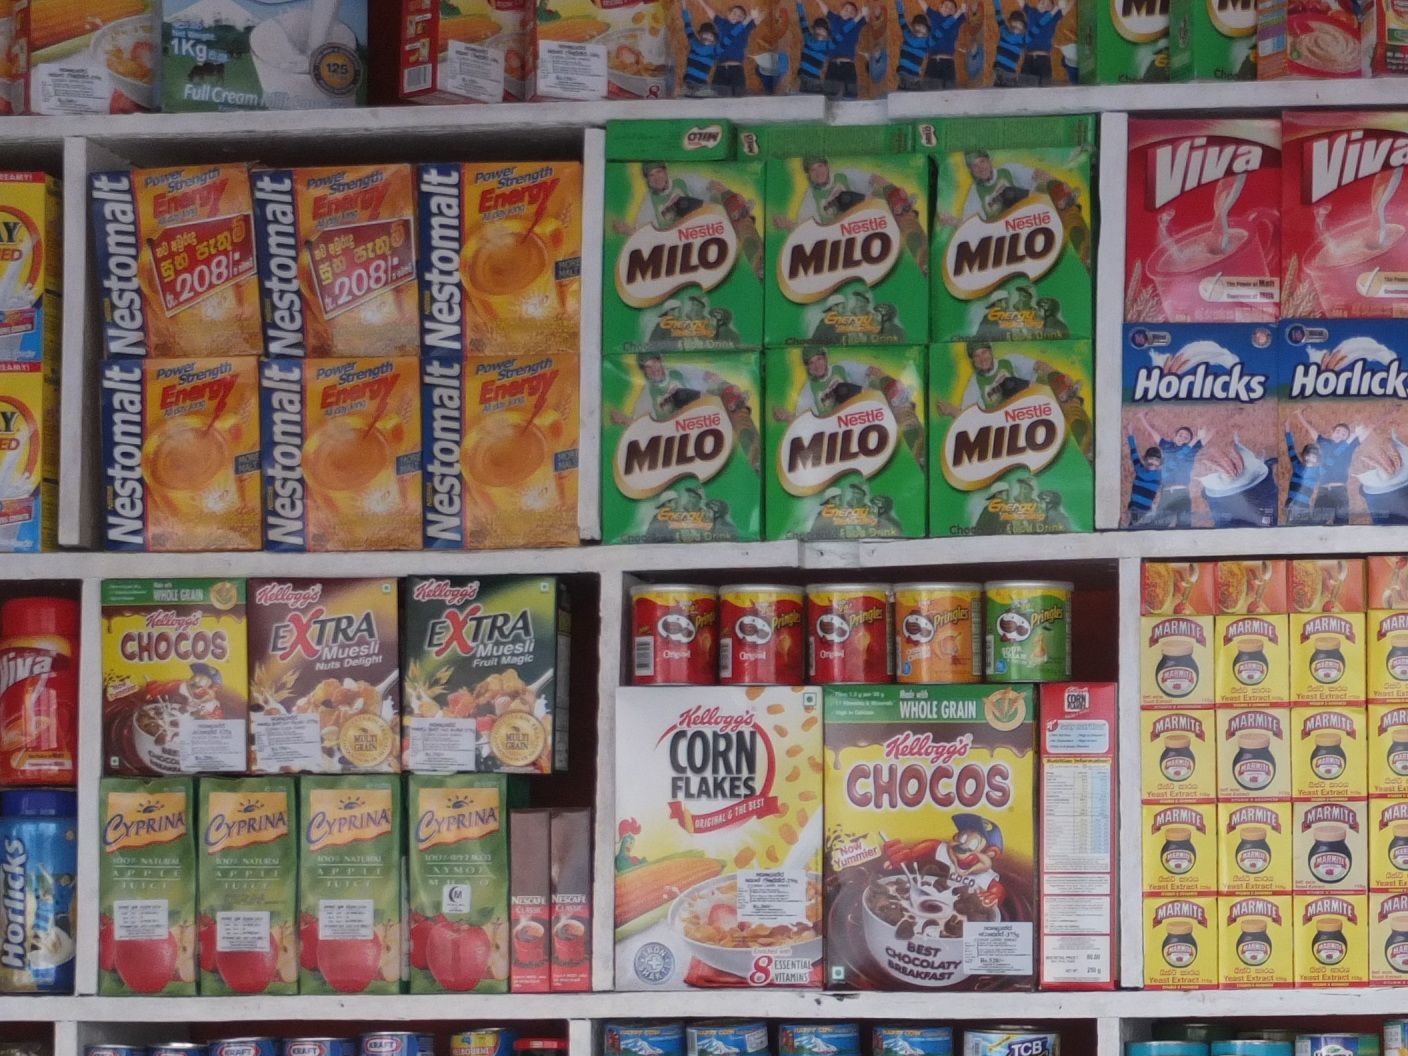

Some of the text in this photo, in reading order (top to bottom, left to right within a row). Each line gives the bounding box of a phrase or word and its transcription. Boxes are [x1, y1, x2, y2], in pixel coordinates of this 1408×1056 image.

[1155, 137, 1263, 208] Viva
[93, 175, 146, 355] Nestomalt
[424, 165, 460, 350] Nestomalt
[626, 237, 729, 285] MILO
[789, 234, 891, 281] MILO
[953, 228, 1056, 278] MILO
[156, 362, 197, 379] Power
[178, 361, 232, 386] Strength
[1134, 362, 1267, 401] Horlicks
[159, 373, 238, 408] Energy
[262, 363, 305, 541] Nestomalt
[424, 359, 464, 541] Nestomalt
[624, 427, 725, 474] MILO
[952, 418, 1057, 470] MILO
[146, 610, 201, 628] Kellogg's
[271, 608, 376, 660] EXTRA
[428, 608, 533, 660] EXTRA
[1155, 622, 1203, 638] MARMITE
[1304, 619, 1354, 635] MARMITE
[121, 631, 229, 663] CHOCOS
[322, 641, 380, 660] Muesli
[477, 640, 535, 658] Muesli
[679, 705, 757, 731] Kellogg's
[900, 700, 976, 719] WHOLE GRAIN
[669, 730, 757, 776] CORN
[885, 732, 969, 758] Kellogg's
[671, 775, 757, 800] FLAKES
[847, 763, 1011, 810] CHOCOS
[102, 809, 186, 845] CYPRINA
[306, 809, 391, 844] CYPRINA
[416, 805, 497, 844] CYPRINA
[694, 813, 727, 829] ORIGINAL
[735, 803, 747, 816] THE
[748, 799, 764, 812] BEST
[833, 845, 879, 868] Yummier
[839, 843, 863, 857] Now
[774, 958, 811, 972] ESSENTIAL
[886, 947, 963, 970] CHOCOLATY
[906, 942, 942, 957] BEST
[752, 957, 772, 983] 8
[774, 971, 809, 983] VITAMINS
[1013, 1041, 1043, 1056] TCB
